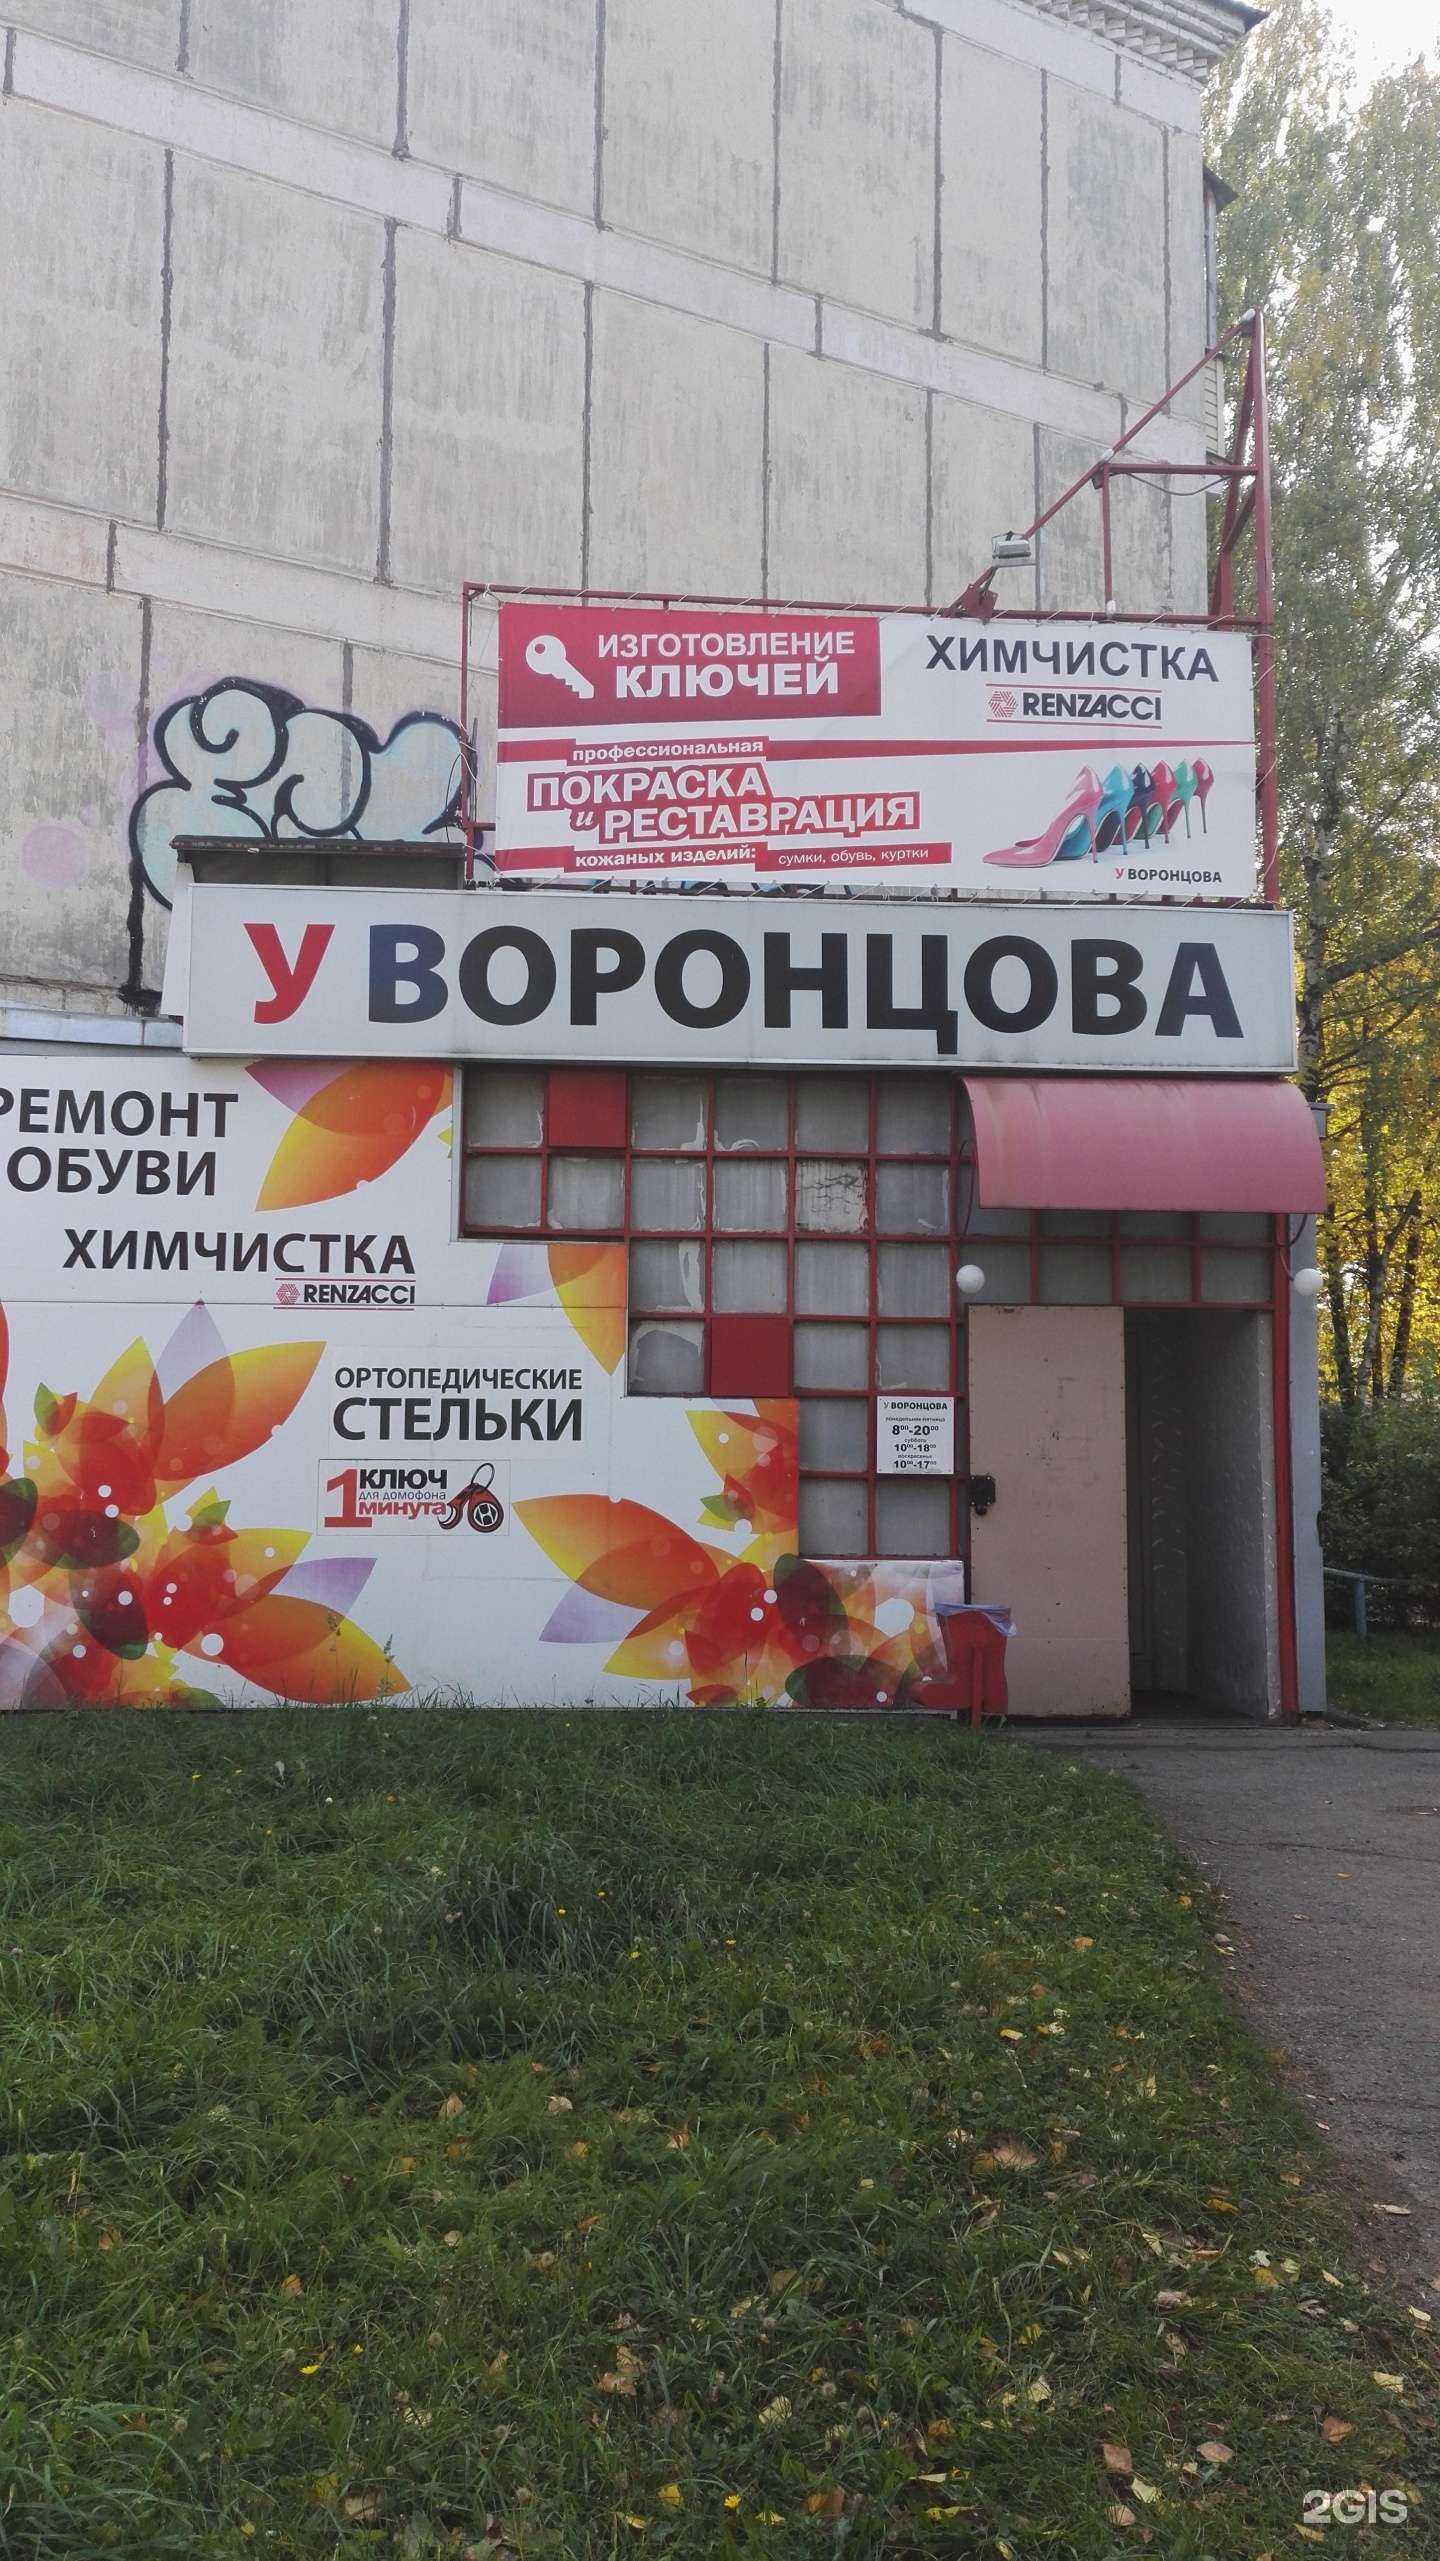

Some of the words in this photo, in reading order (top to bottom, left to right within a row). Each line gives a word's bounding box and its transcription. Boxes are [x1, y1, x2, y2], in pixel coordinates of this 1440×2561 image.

[598, 631, 855, 658] ИЗГОТОВЛЕНИЕ
[926, 634, 1219, 682] ХИМЧИСТКА
[616, 655, 838, 698] КЛЮЧЕЙ
[1022, 692, 1162, 721] RENZACCI
[572, 740, 763, 763] профессиональная
[532, 767, 766, 807] ПОКРАСКА
[575, 810, 594, 826] и
[604, 796, 914, 839] РЕСТАВРАЦИЯ
[575, 851, 664, 867] кожаных
[671, 844, 756, 863] изделий:
[778, 853, 826, 866] сумки,
[831, 849, 876, 863] обувь,
[881, 848, 929, 861] куртки
[1115, 868, 1124, 880] У
[1128, 869, 1222, 885] ВОРОНЦОВА
[243, 923, 336, 1024] У
[368, 924, 1244, 1054] ВОРОНЦОВА
[7, 1146, 217, 1196] ОБУВИ
[62, 1228, 416, 1274] ХИМЧИСТКА
[303, 1285, 415, 1305] RENZACCI
[334, 1367, 583, 1394] ОРТОПЕДИЧЕСКИЕ
[333, 1397, 583, 1441] СТЕЛЬКИ
[891, 1402, 948, 1410] ВОРОНЦОВА
[324, 1469, 372, 1528] 1
[358, 1492, 378, 1501] для
[383, 1491, 446, 1501] домофона
[359, 1501, 447, 1519] минута
